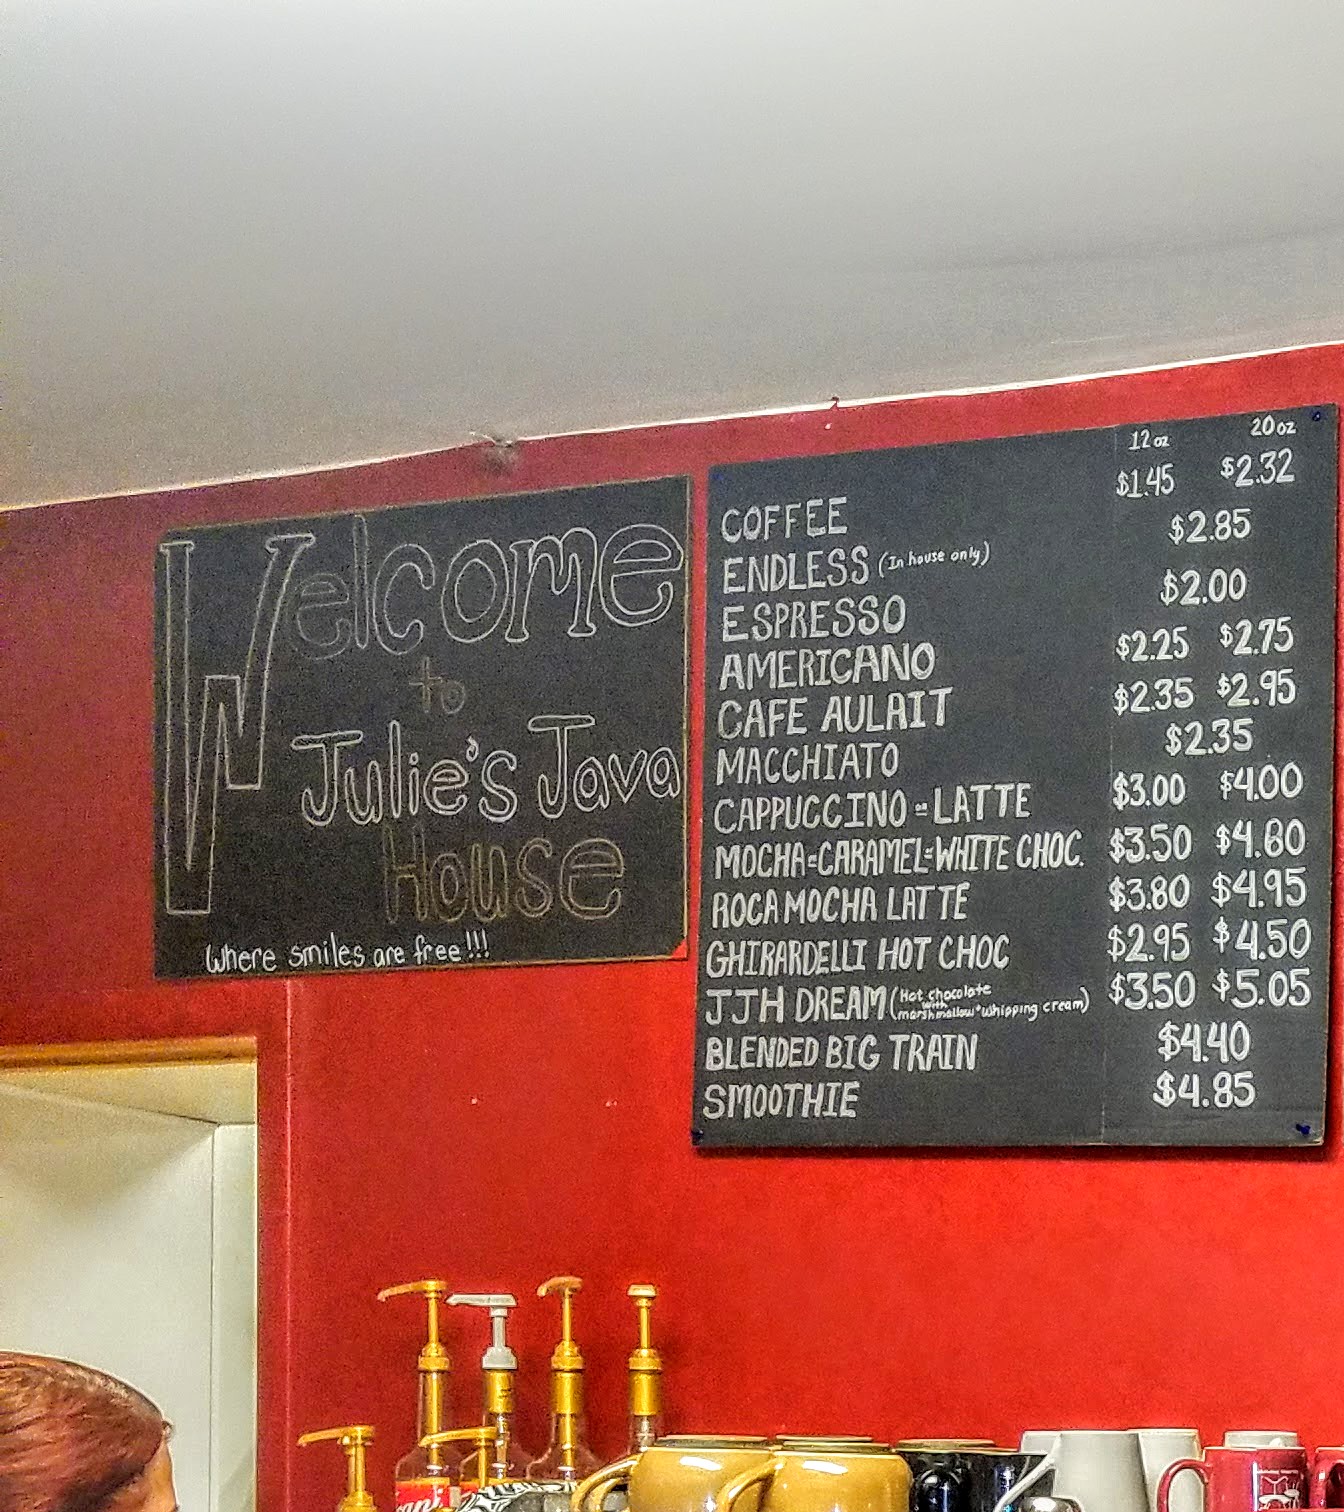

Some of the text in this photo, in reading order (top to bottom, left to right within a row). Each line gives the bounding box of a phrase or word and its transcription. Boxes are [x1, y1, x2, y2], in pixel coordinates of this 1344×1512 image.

[721, 448, 1295, 543] COFFEE $1.45 $2.32
[1168, 508, 1251, 545] $2.85
[723, 546, 869, 594] ENDLESS
[907, 551, 945, 566] house
[951, 541, 990, 566] only)
[721, 568, 1247, 642] ESPRESSO $2.00
[719, 617, 1293, 691] AMERICANO $2.25 $2.75
[160, 515, 684, 915] Welcome
[718, 697, 807, 739] CAFE
[1113, 677, 1193, 716] $2.35
[1217, 669, 1295, 706] $2.95
[291, 714, 680, 826] Julie's Java
[717, 718, 1253, 785] MACCHIATO $2.35
[714, 762, 1303, 833] CAPPUCCINO LATTE $3.00 $4.00
[383, 822, 625, 924] House
[887, 882, 970, 920] LATTE
[1109, 874, 1190, 912] $3.80
[1211, 867, 1307, 907] $4.95
[205, 928, 491, 974] Where smiles are free!!!
[703, 1071, 1255, 1119] SMOOTHIE $4.85
